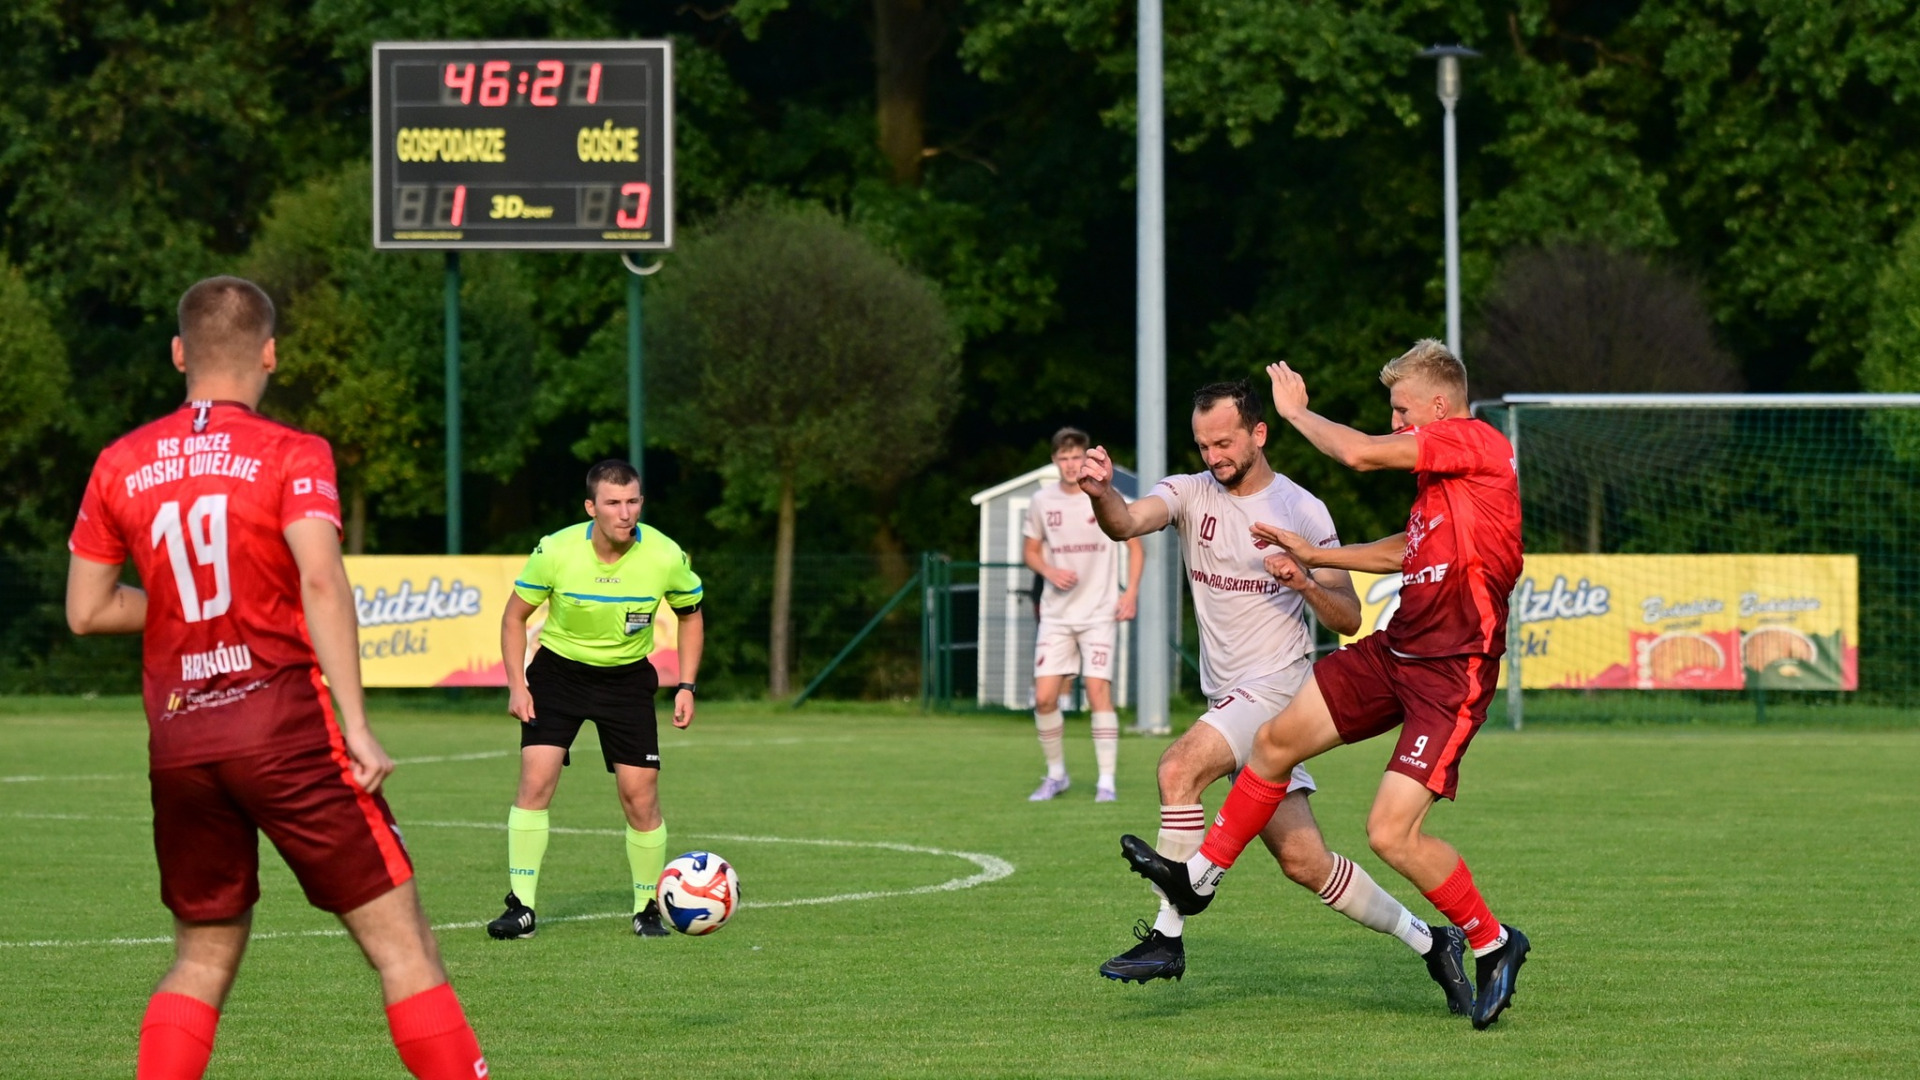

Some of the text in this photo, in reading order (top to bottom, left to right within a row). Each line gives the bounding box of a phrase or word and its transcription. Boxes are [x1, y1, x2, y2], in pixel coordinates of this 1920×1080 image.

[444, 60, 602, 107] 46:21
[397, 119, 640, 163] GOSPODARZE GOŚCIE
[157, 438, 180, 458] KS
[125, 452, 262, 498] PIASKI WIELKIE
[1046, 511, 1062, 527] 20
[1199, 513, 1217, 541] 10
[151, 493, 231, 623] 19
[354, 576, 481, 627] kidzkie
[359, 629, 430, 660] celki
[1410, 735, 1429, 758] 9
